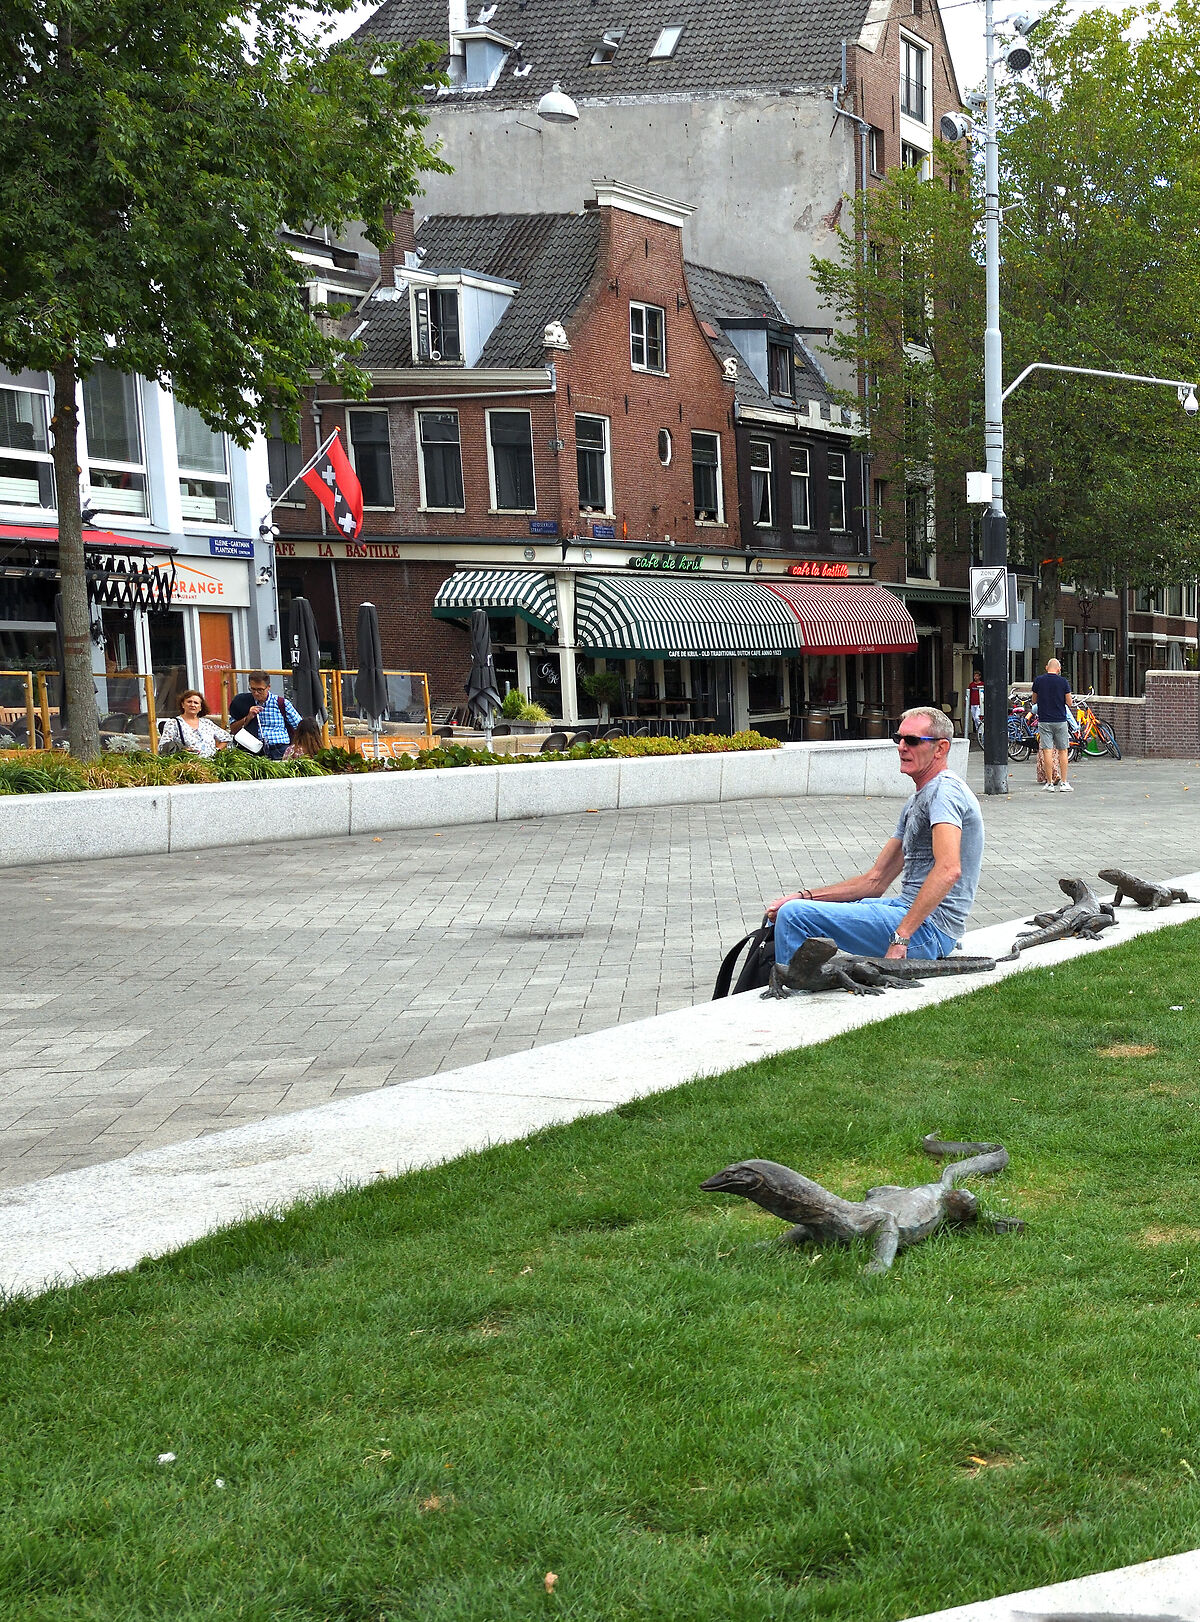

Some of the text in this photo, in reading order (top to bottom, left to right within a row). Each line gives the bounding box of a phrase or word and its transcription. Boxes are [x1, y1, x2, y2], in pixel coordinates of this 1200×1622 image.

[318, 543, 334, 557] LA
[662, 554, 676, 570] de
[678, 555, 705, 571] krul
[792, 561, 849, 578] cafe la bastille
[260, 566, 273, 578] 25
